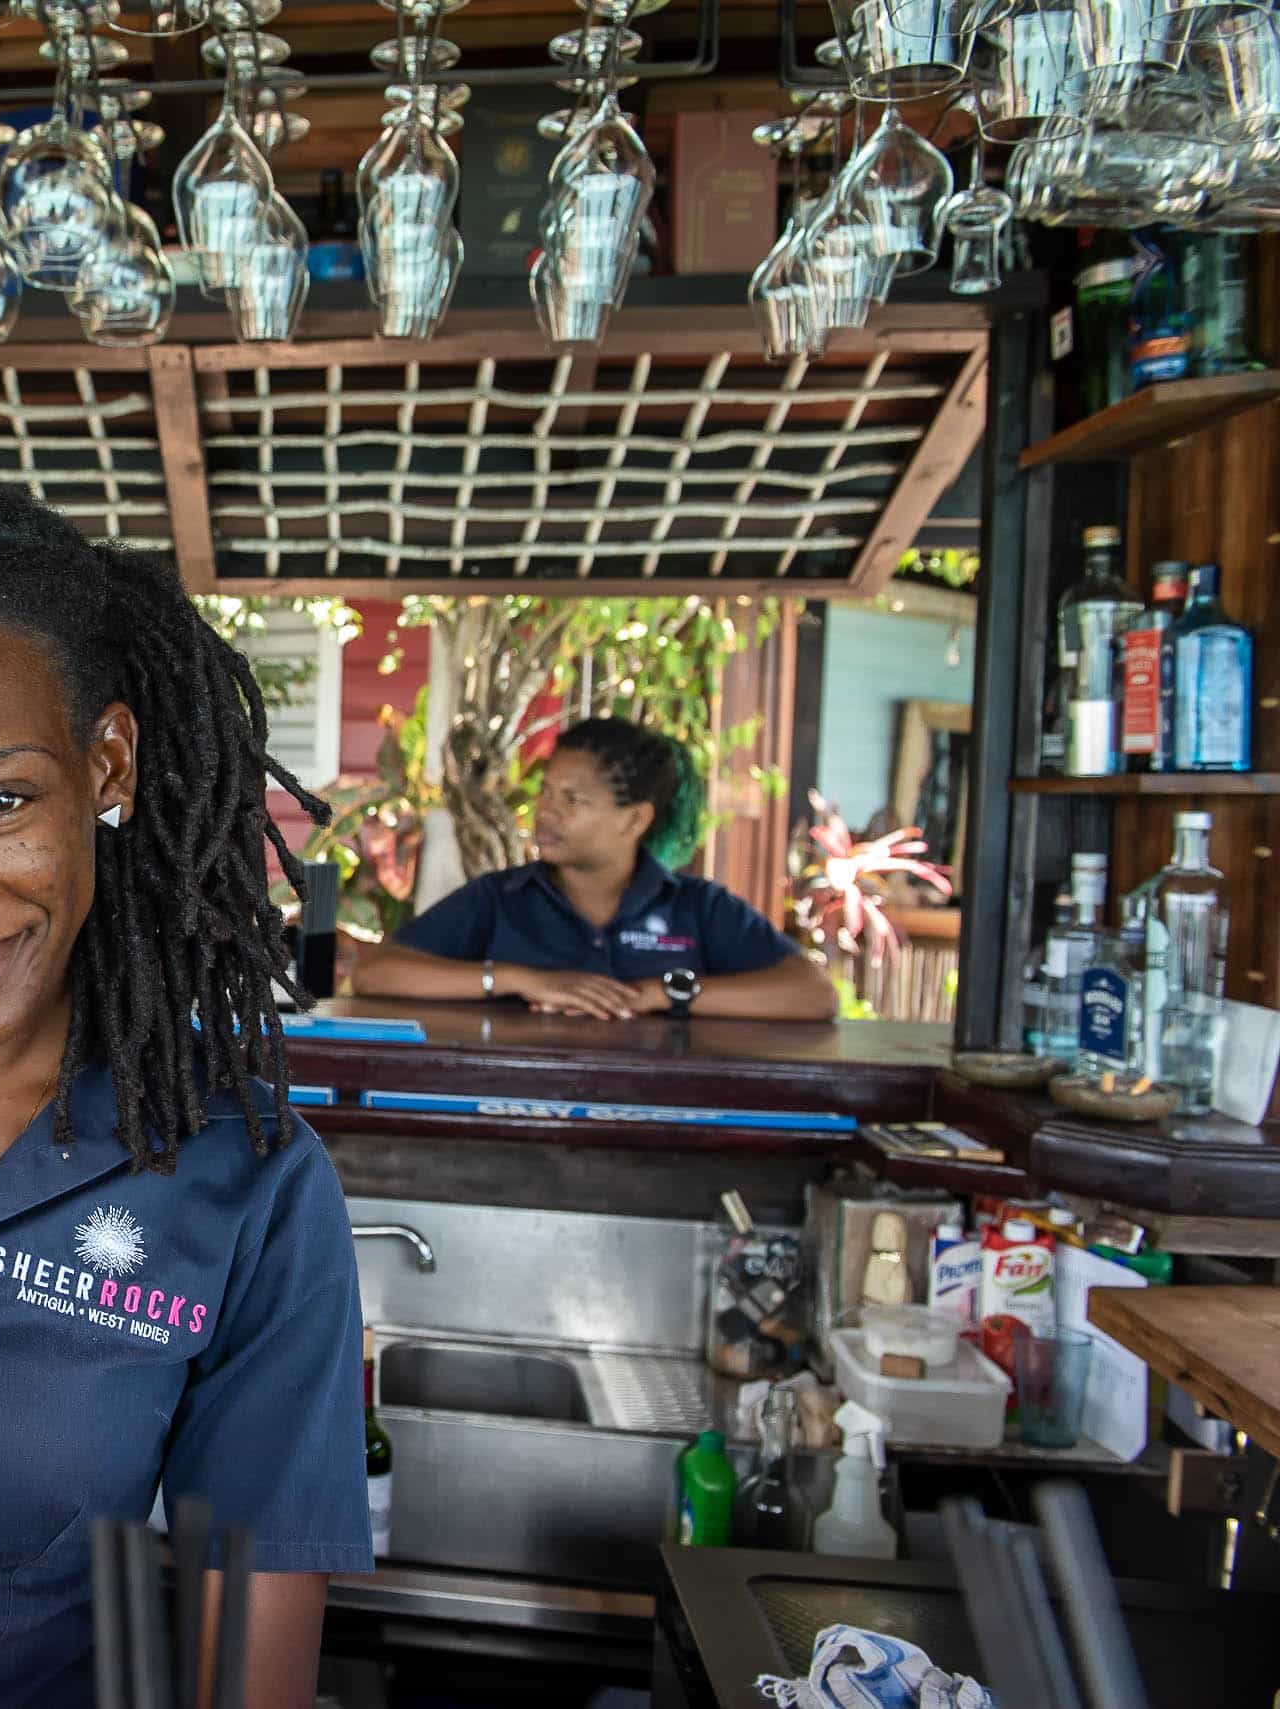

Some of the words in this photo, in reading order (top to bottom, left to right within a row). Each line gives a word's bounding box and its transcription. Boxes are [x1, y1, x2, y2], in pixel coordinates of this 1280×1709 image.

[16, 1286, 75, 1317] ANTIGUA
[87, 1307, 126, 1331] WEST
[129, 1319, 171, 1345] INDIES
[99, 1279, 208, 1333] ROCKS
